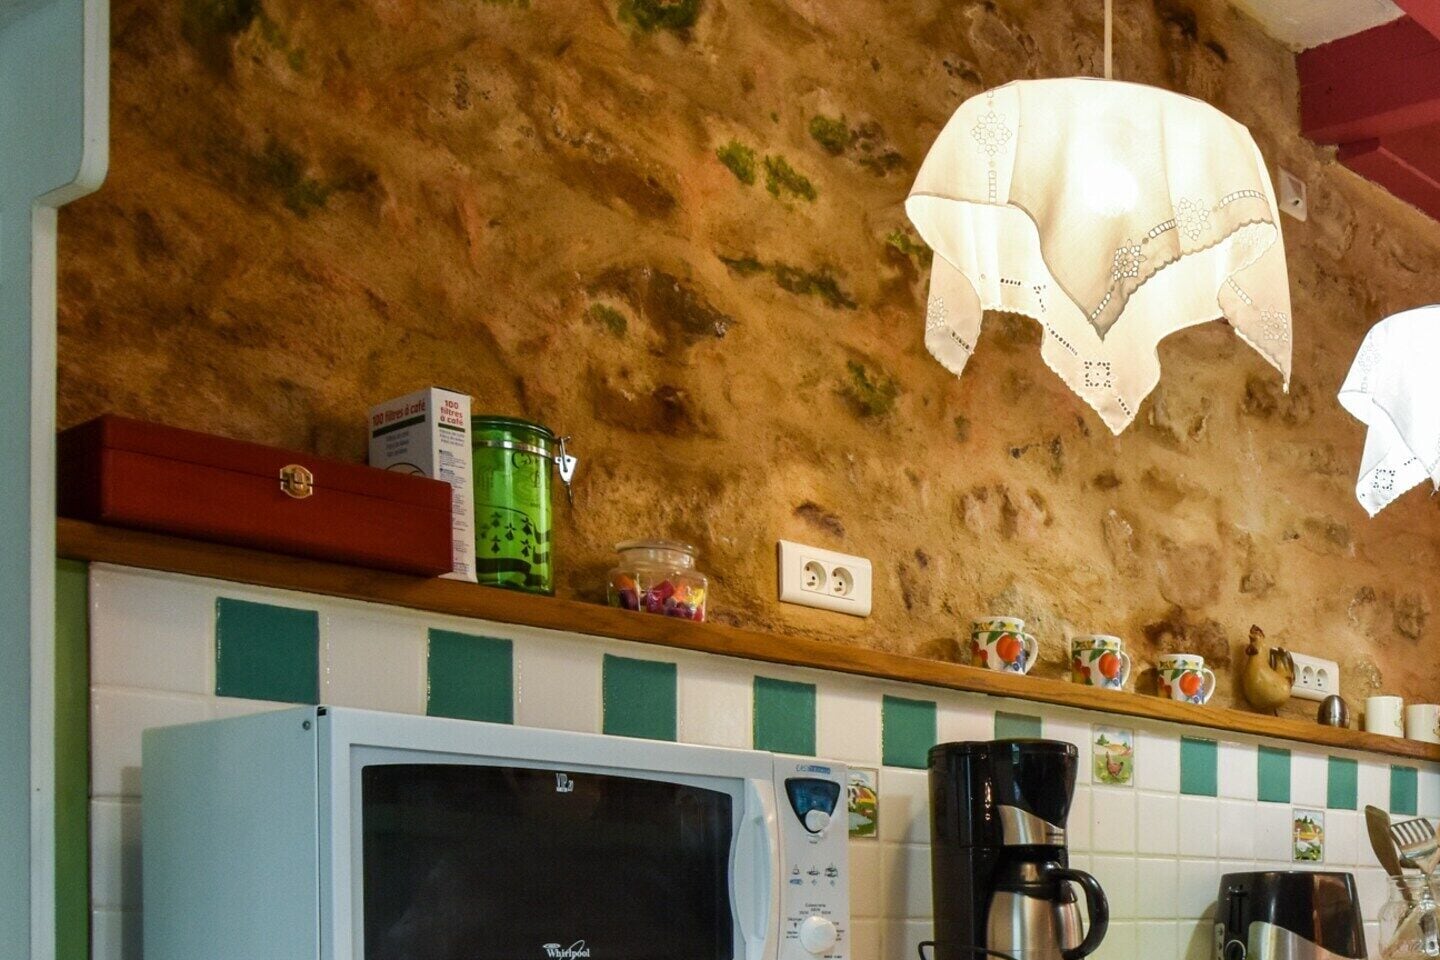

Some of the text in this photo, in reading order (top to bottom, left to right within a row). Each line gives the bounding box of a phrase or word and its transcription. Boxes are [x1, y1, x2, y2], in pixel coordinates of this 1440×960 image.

[444, 400, 459, 410] 100
[440, 406, 464, 419] filtres
[546, 948, 590, 960] Whirlpool
